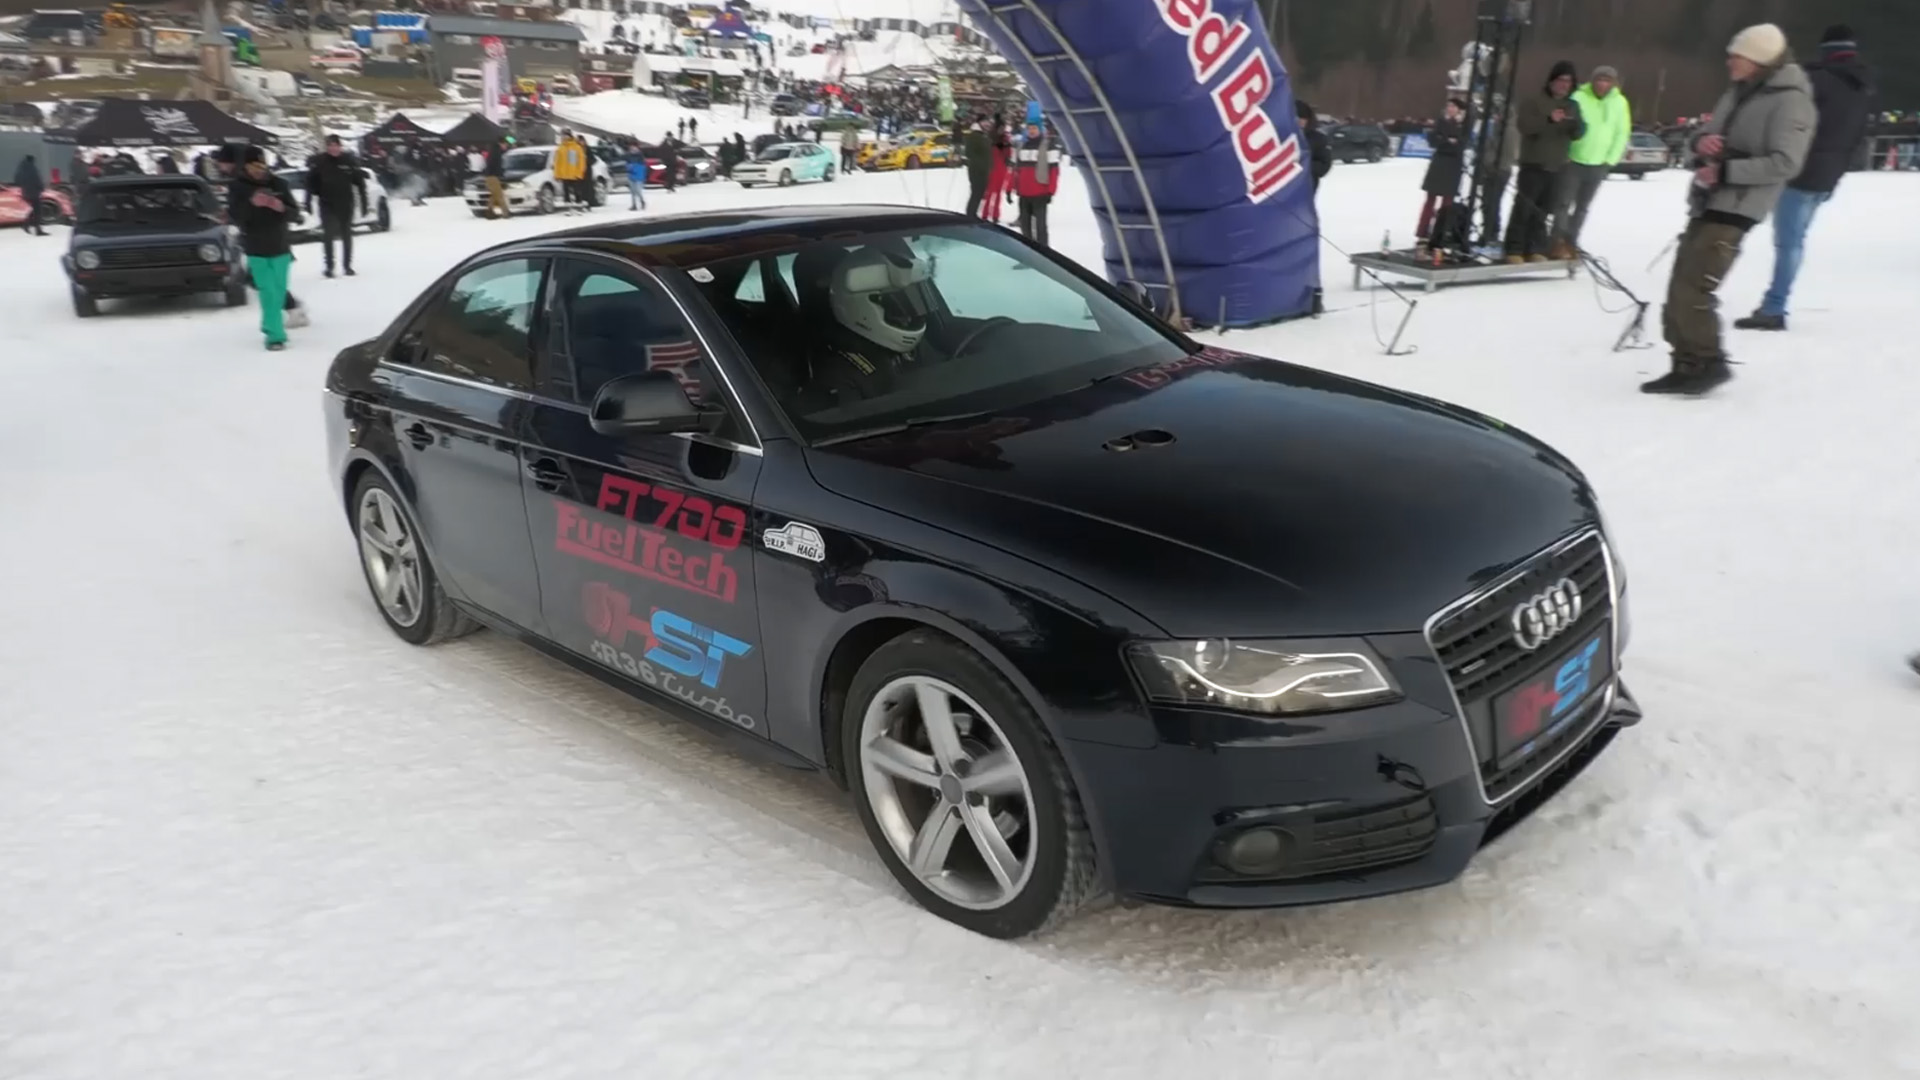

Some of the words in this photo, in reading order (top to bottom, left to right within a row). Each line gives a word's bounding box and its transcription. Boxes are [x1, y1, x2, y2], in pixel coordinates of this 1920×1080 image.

[1155, 0, 1251, 84] ed
[1210, 46, 1303, 204] Bull
[554, 499, 739, 604] FuelTech
[797, 543, 818, 559] HAGI
